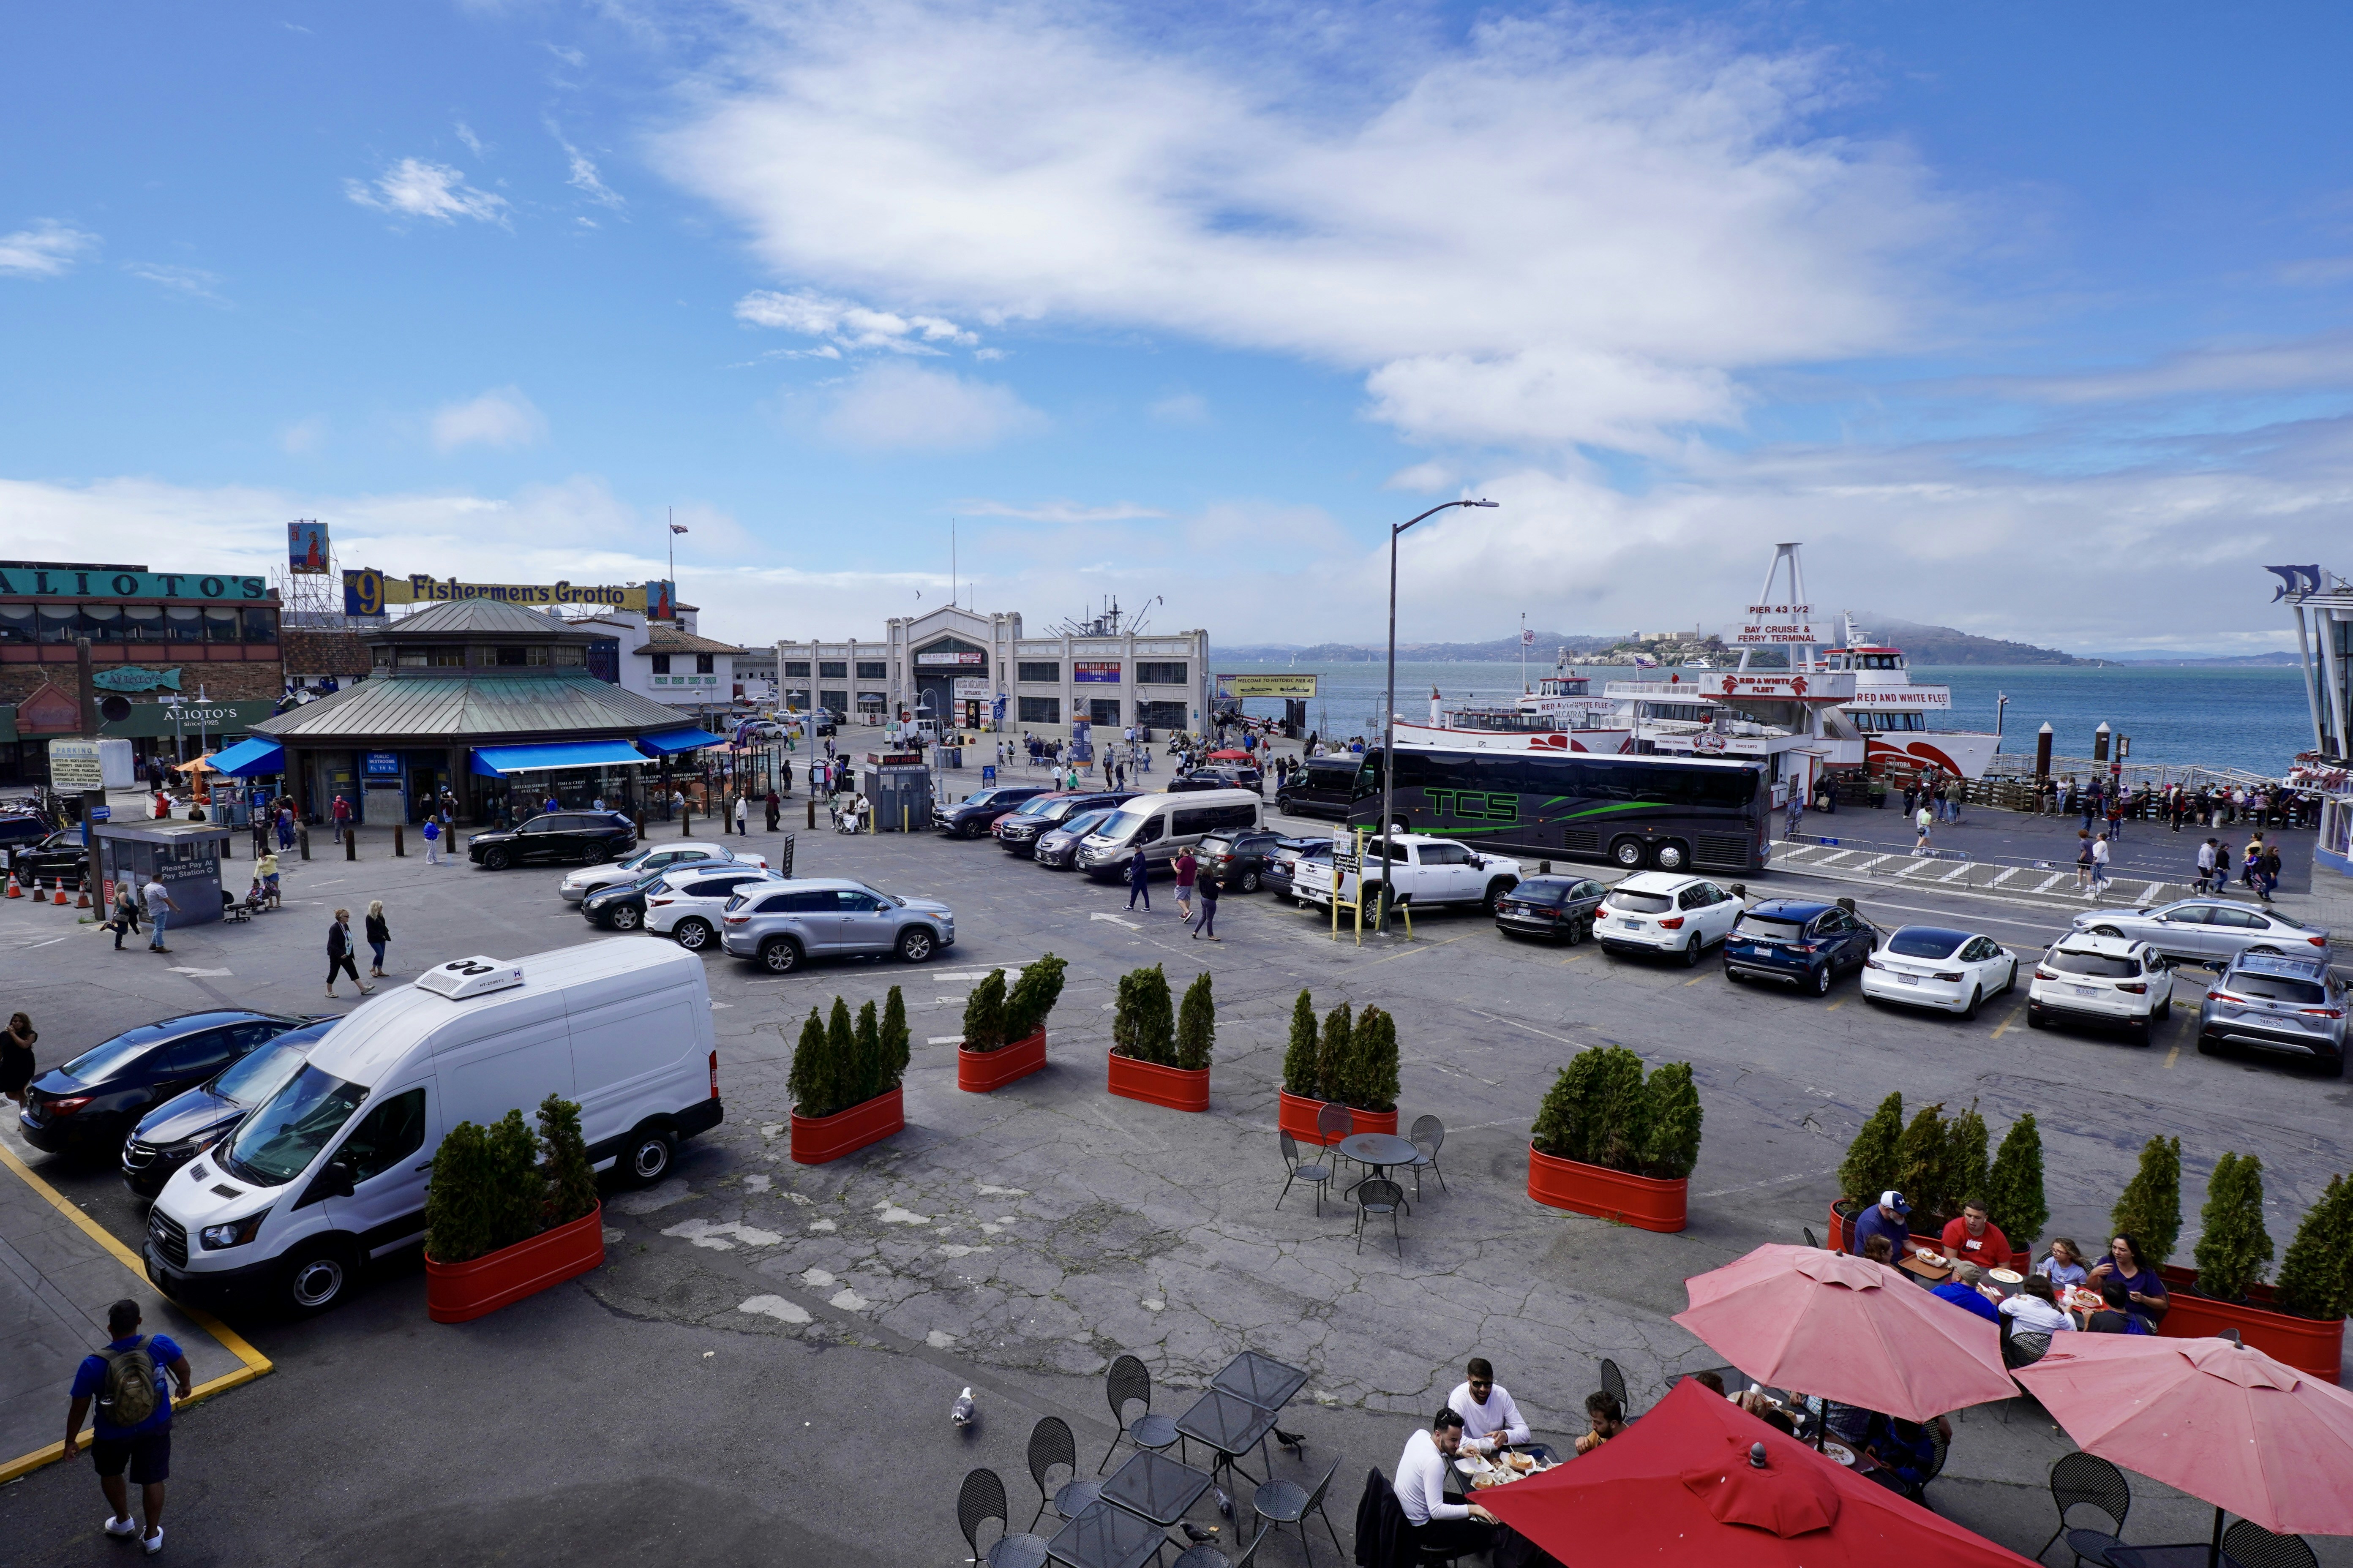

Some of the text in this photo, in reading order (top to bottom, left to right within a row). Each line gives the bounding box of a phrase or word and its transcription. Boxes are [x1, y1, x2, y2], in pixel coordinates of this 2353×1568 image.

[292, 531, 299, 541] 9
[356, 572, 383, 614] 9
[410, 574, 624, 603] Fishermen's Grotto
[1857, 693, 1948, 702] RED AND WHITE FLEET
[163, 708, 237, 720] ALIOTO'S
[746, 736, 756, 747] HUT
[1424, 788, 1518, 822] TCS
[178, 869, 205, 877] Station
[2259, 1019, 2282, 1027] 9AAH254
[1966, 1239, 1983, 1250] NIKE
